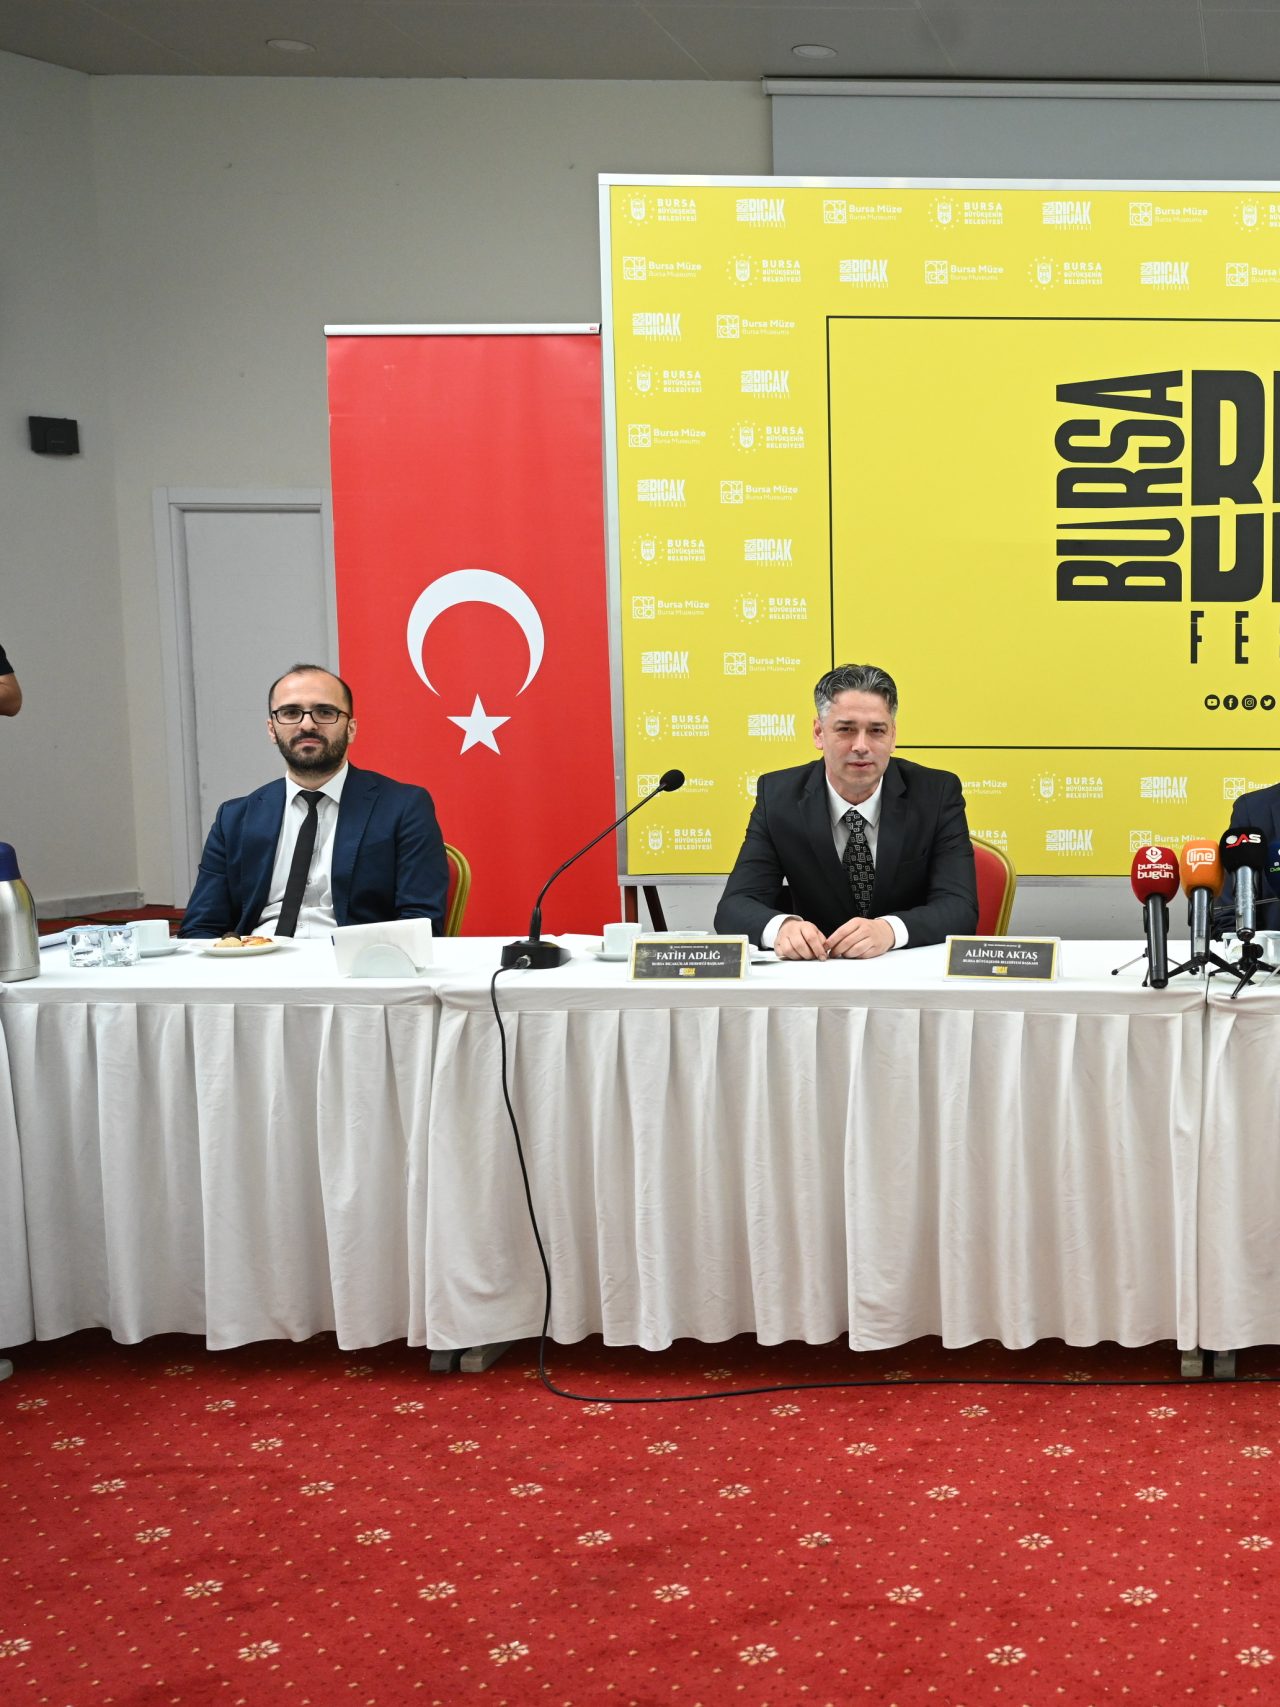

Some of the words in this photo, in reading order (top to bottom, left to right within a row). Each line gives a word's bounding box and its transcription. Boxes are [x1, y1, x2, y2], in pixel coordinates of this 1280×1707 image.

[658, 199, 696, 207] BURSA
[964, 202, 1003, 210] BURSA
[849, 205, 874, 213] Bursa
[877, 205, 902, 213] Müze
[1155, 207, 1180, 215] Bursa
[1183, 207, 1208, 215] Müze
[649, 261, 674, 269] Bursa
[677, 261, 702, 269] Müze
[762, 260, 800, 268] BURSA
[1064, 262, 1103, 270] BURSA
[951, 265, 976, 273] Bursa
[979, 265, 1004, 273] Müze
[1252, 267, 1277, 275] Bursa
[742, 319, 767, 327] Bursa
[770, 319, 795, 327] Müze
[664, 370, 702, 378] BURSA
[653, 429, 678, 437] Bursa
[681, 429, 705, 437] Müze
[766, 426, 805, 434] BURSA
[745, 485, 770, 493] Bursa
[773, 485, 797, 493] Müze
[1054, 369, 1185, 602] BURSA
[668, 539, 706, 547] BURSA
[657, 600, 682, 608] Bursa
[685, 600, 709, 608] Müze
[769, 598, 806, 606] BURSA
[776, 657, 800, 665] Müze
[672, 715, 709, 723] BURSA
[982, 780, 1008, 788] Müze
[1066, 777, 1103, 785] BURSA
[675, 829, 712, 837] BURSA
[1155, 834, 1180, 843] Bursa
[1190, 850, 1214, 860] line
[1138, 862, 1173, 870] bursada
[1138, 870, 1174, 879] bugün
[966, 949, 1004, 958] ALİNUR
[1006, 951, 1038, 960] AKTAŞ
